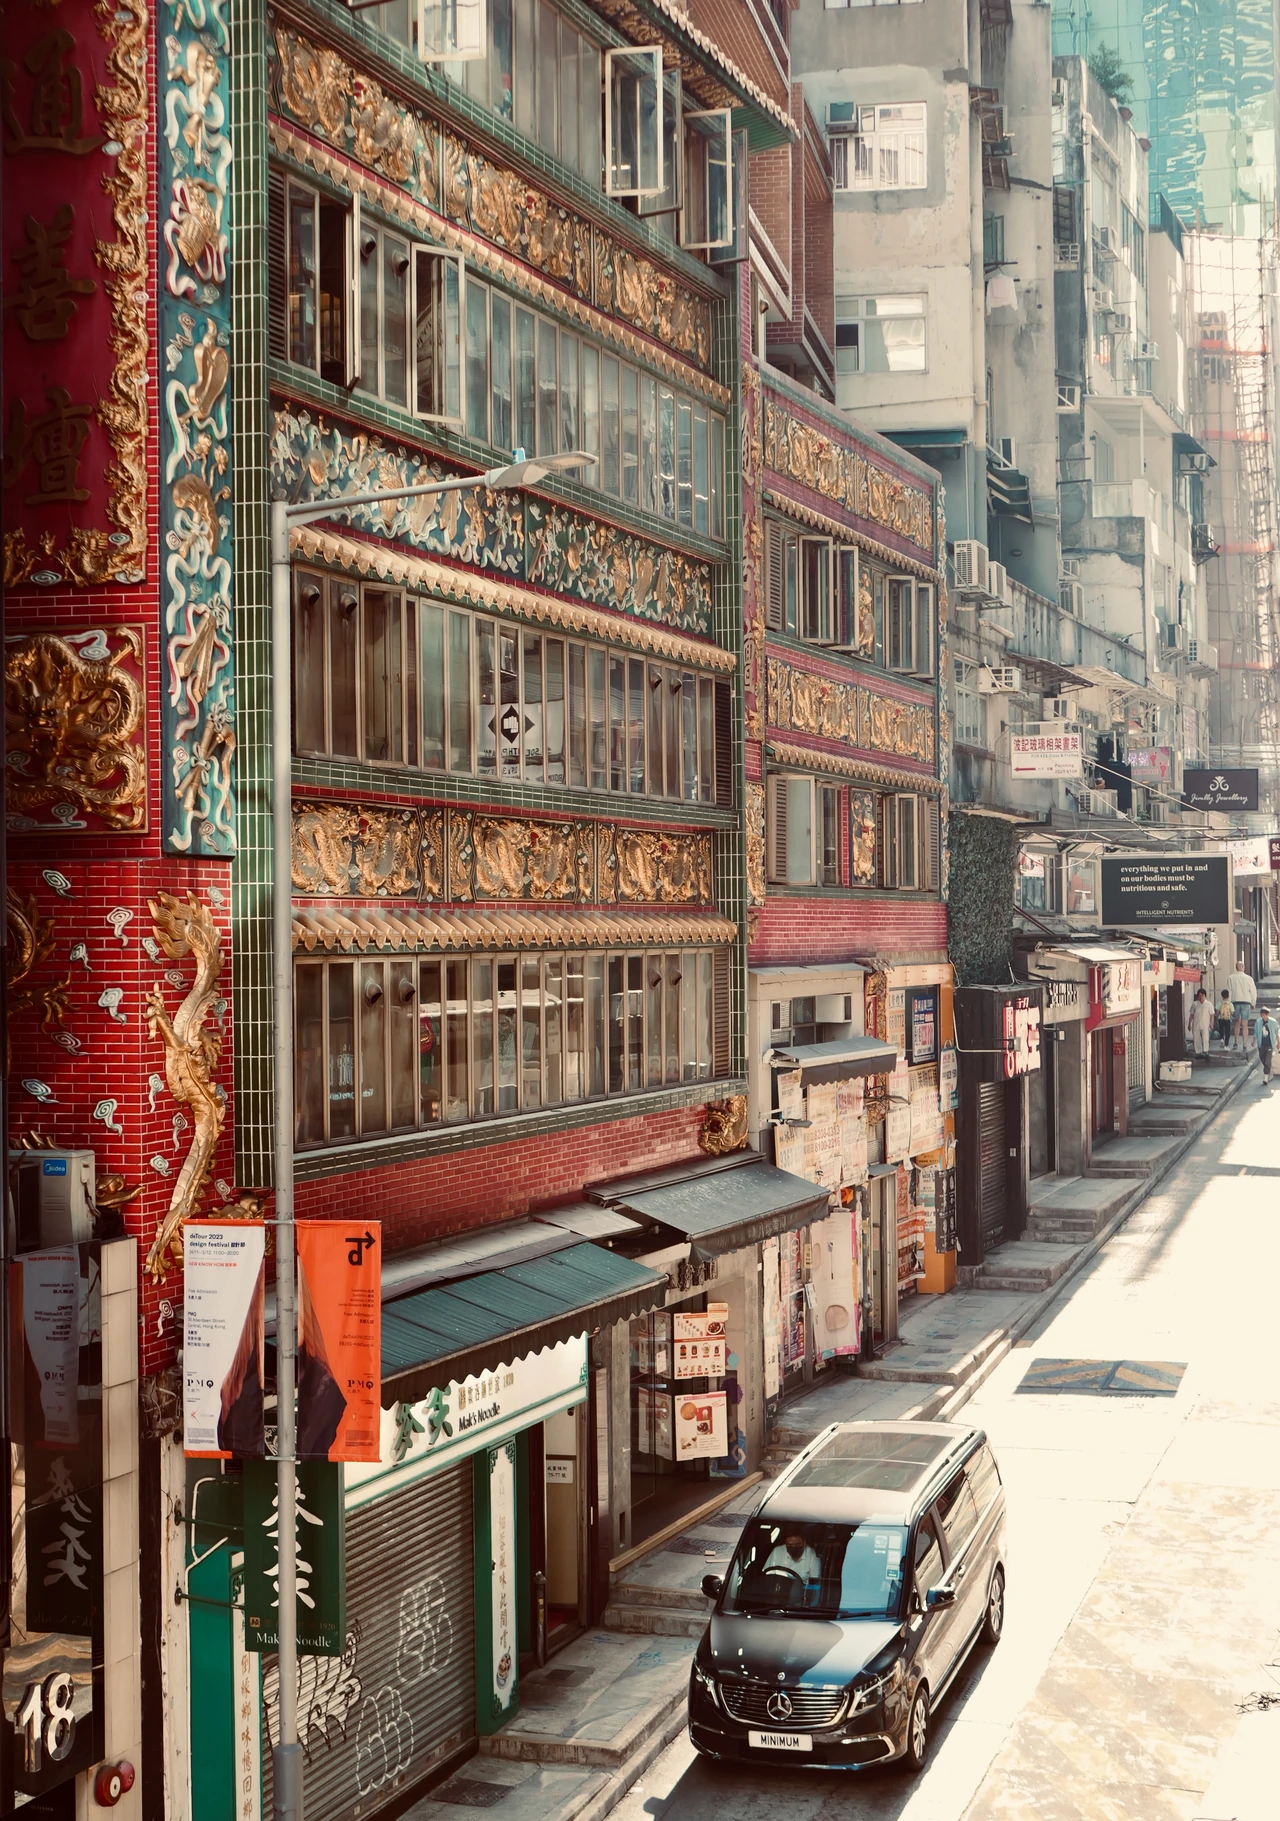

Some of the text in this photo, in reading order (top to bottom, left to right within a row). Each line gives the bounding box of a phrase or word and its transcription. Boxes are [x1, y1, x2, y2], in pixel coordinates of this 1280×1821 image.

[1121, 865, 1158, 874] everything
[1172, 865, 1183, 873] put
[187, 1379, 214, 1388] PMQ
[347, 1380, 374, 1390] PMQ
[459, 1402, 501, 1431] Mak's Noodle
[14, 1672, 76, 1773] 18
[760, 1734, 800, 1748] MINIMUM
